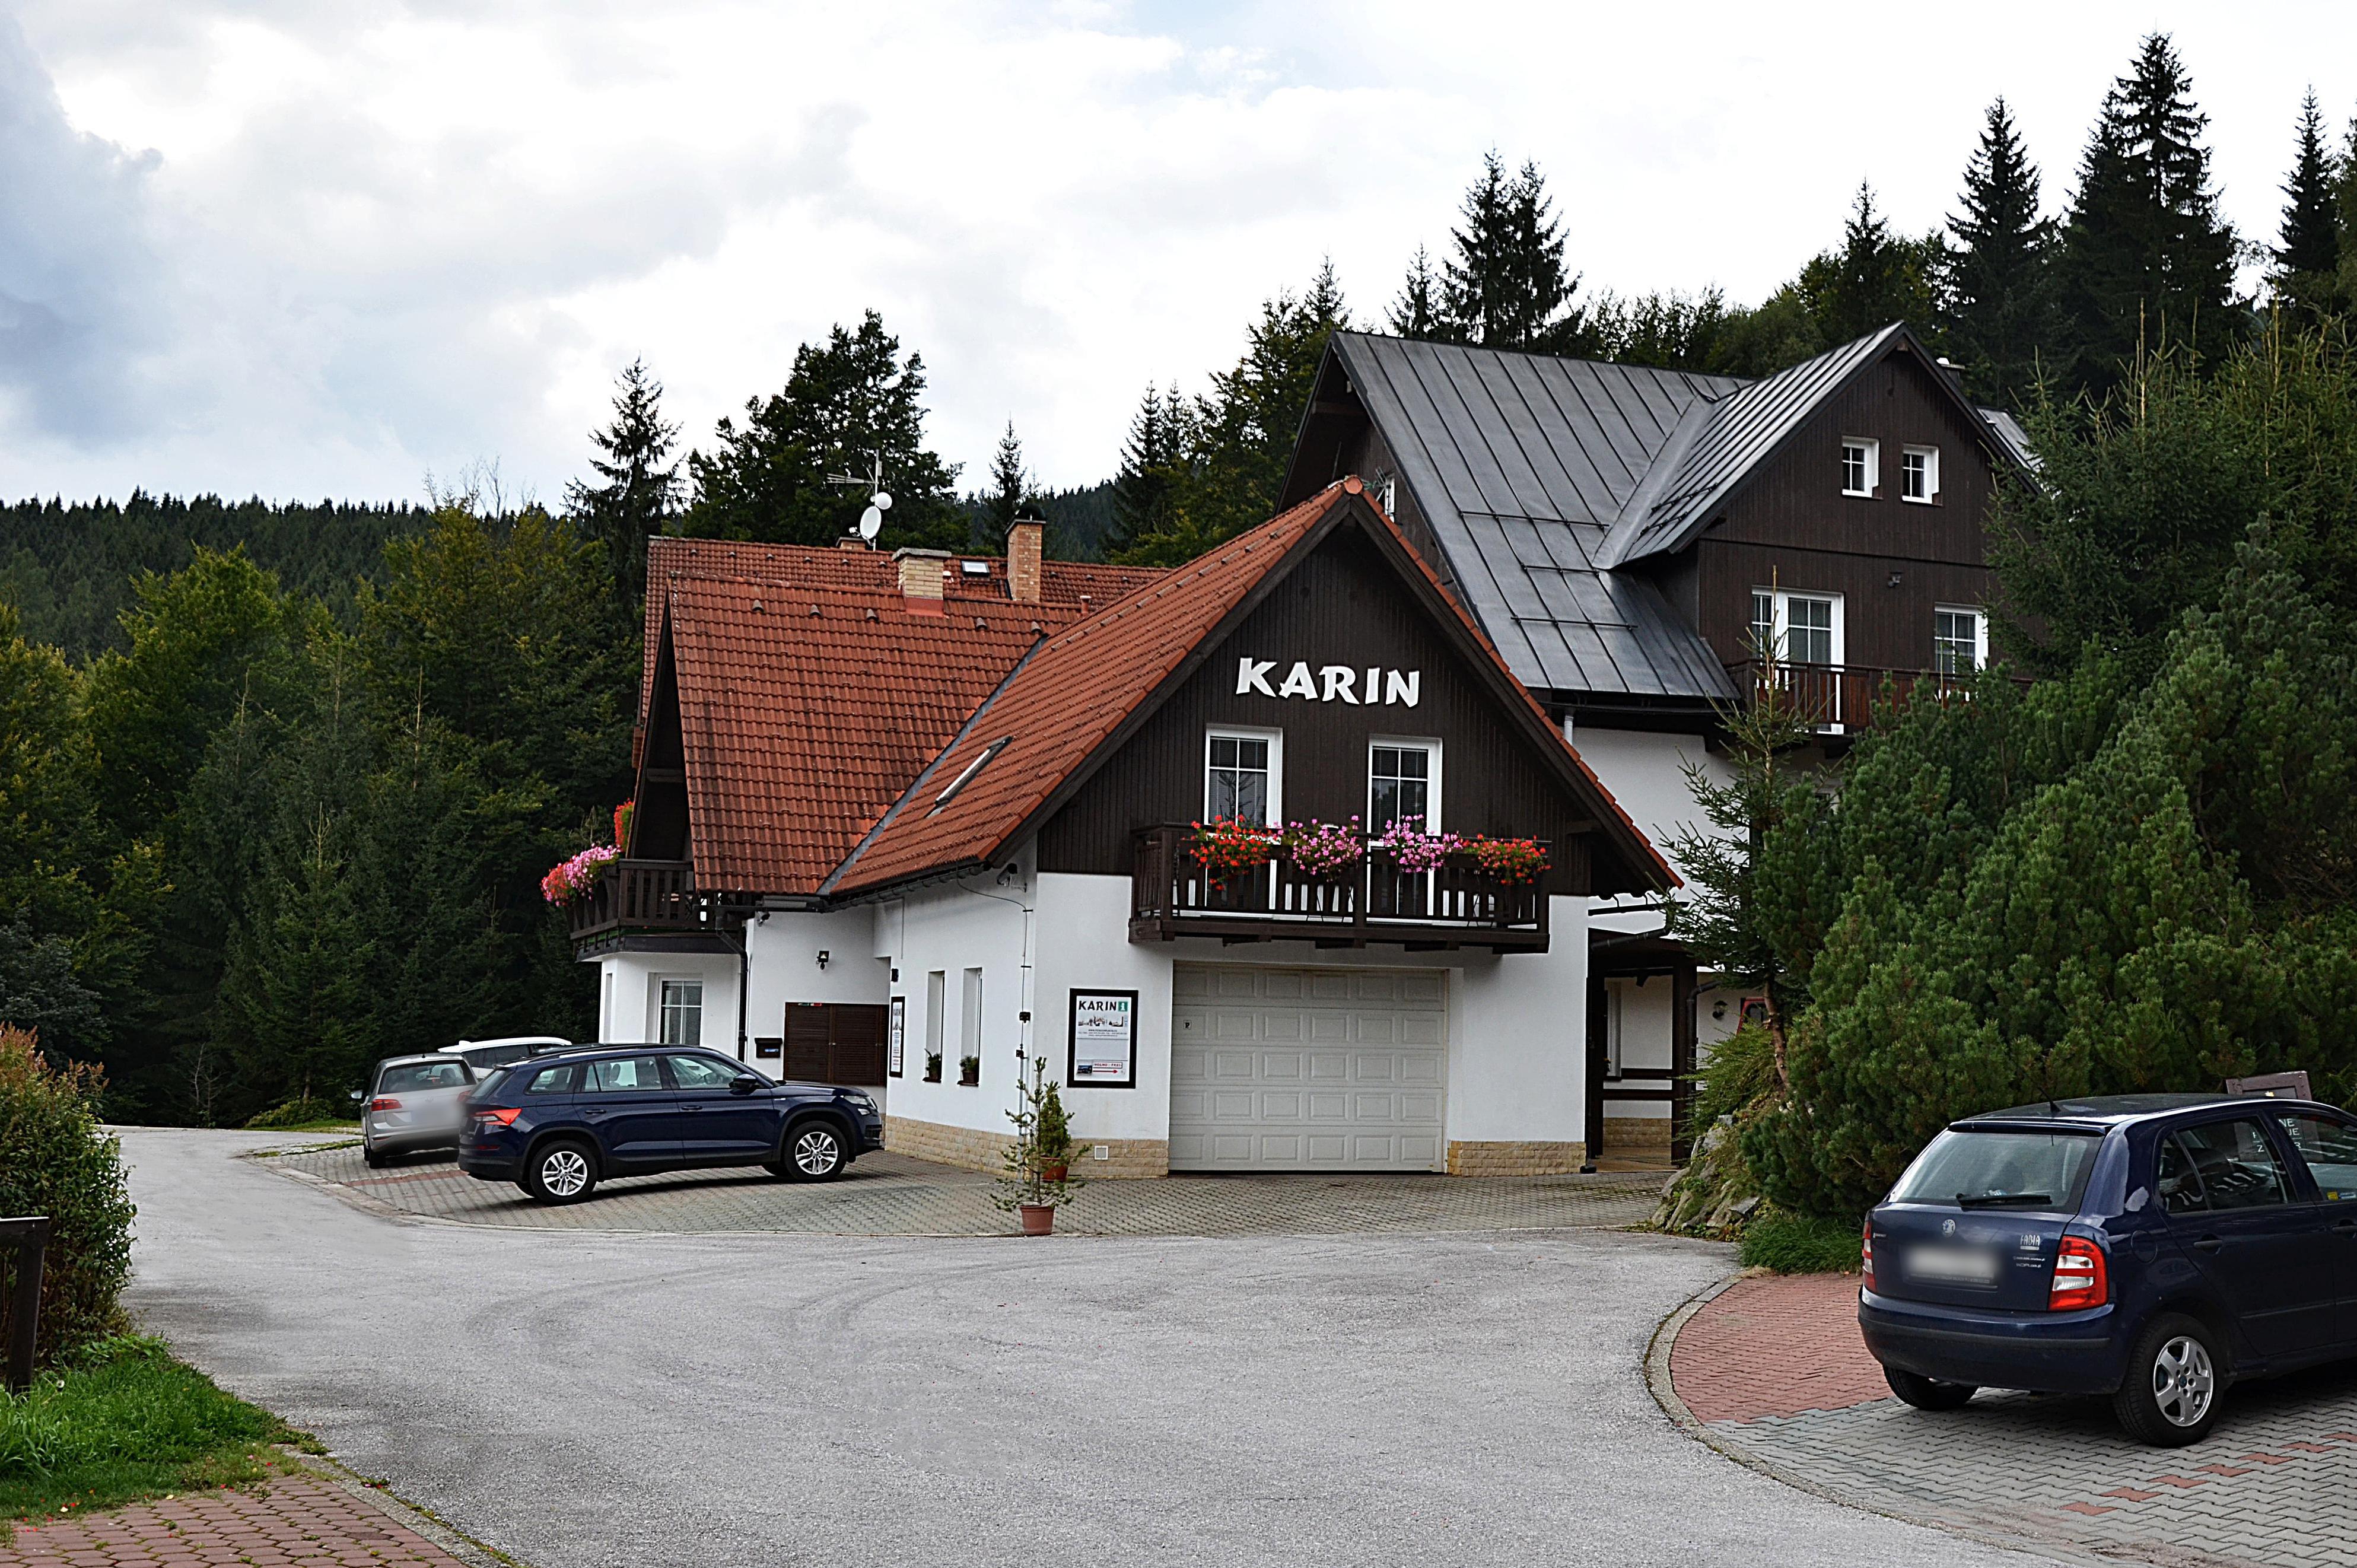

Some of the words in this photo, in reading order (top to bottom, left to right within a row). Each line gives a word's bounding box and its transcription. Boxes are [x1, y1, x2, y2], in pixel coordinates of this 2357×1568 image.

[1235, 656, 1420, 708] KARIN
[1078, 1000, 1117, 1012] KARIN
[2020, 1234, 2041, 1246] FABIA
